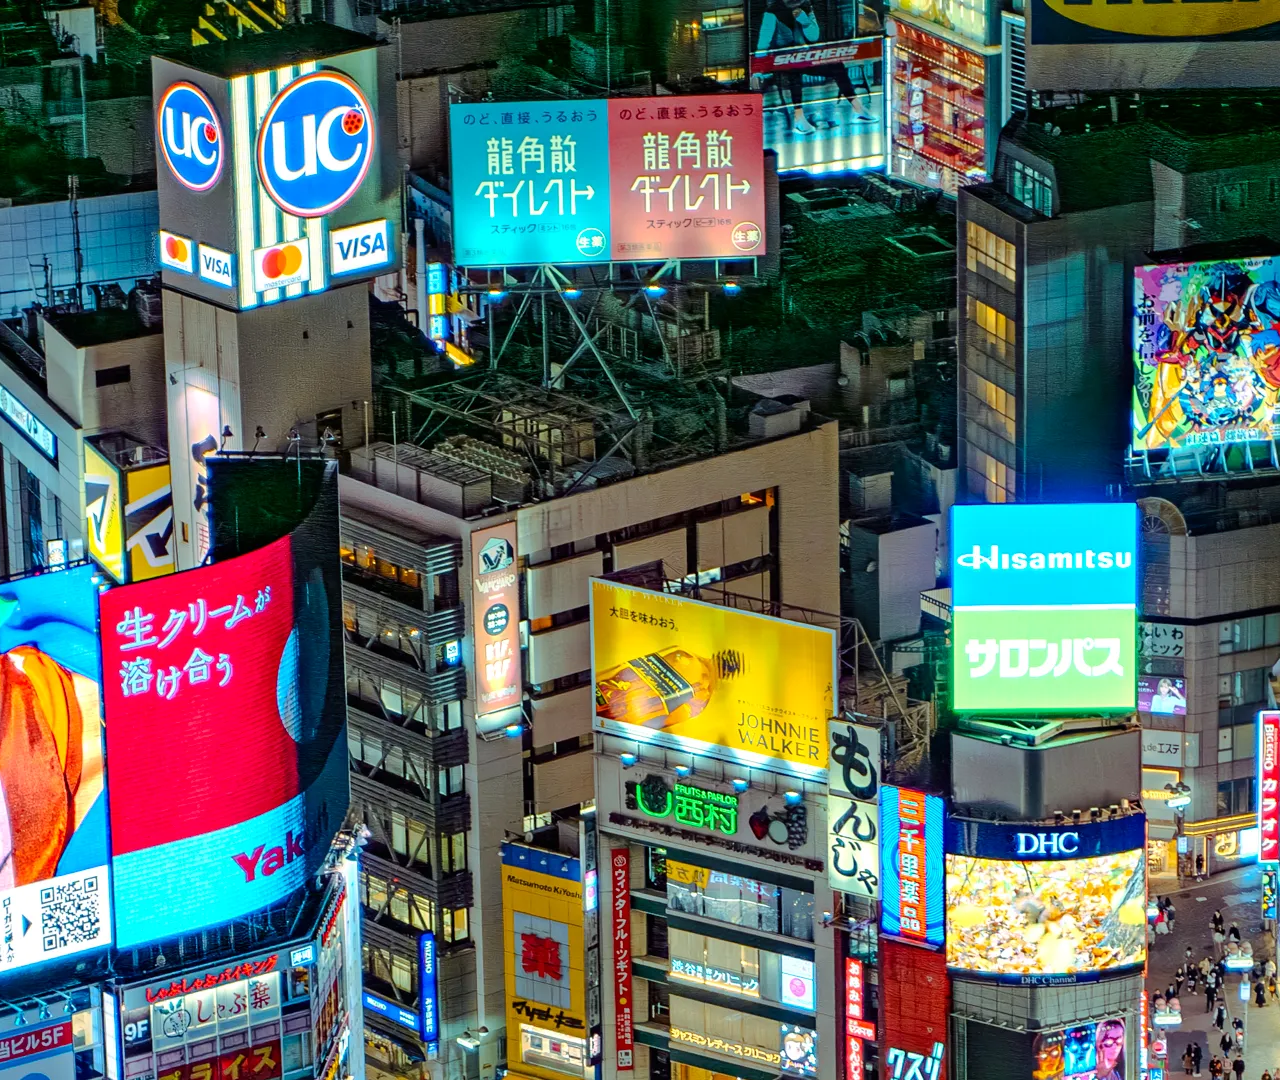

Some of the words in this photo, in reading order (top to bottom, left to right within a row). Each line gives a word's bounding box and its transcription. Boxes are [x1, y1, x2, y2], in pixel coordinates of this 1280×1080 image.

[773, 45, 859, 66] SKECHERS
[487, 134, 577, 175] 龍角散
[643, 129, 733, 170] 龍角散
[475, 178, 595, 218] ダイレクト
[631, 173, 751, 213] ダイレクト
[203, 253, 230, 278] VISA
[335, 232, 386, 261] VISA
[264, 275, 302, 289] mastercard
[956, 544, 1132, 570] Hisamitsu
[116, 584, 272, 651] 生クリームが
[609, 606, 679, 632] 大胆を味わおう。
[119, 647, 234, 700] 溶け合う
[964, 636, 1124, 678] サロンパス
[737, 712, 820, 744] JOHNNIE
[738, 728, 819, 761] WALKER
[675, 796, 737, 835] 西村
[831, 725, 878, 895] もんじゃ
[1262, 777, 1278, 852] カラオケ
[1016, 832, 1079, 854] DHC
[507, 874, 553, 892] Matsumoto
[900, 799, 920, 932] 三千里薬品
[615, 868, 629, 996] ウィンターフルーツギフト
[424, 940, 432, 974] MIZUHO
[521, 932, 563, 982] 薬
[145, 954, 279, 1003] しゃぶしゃぶバイキング
[1021, 976, 1042, 984] DHC
[1042, 975, 1077, 984] Channel
[196, 982, 271, 1023] しゃぶ葉
[124, 1020, 149, 1040] 9F
